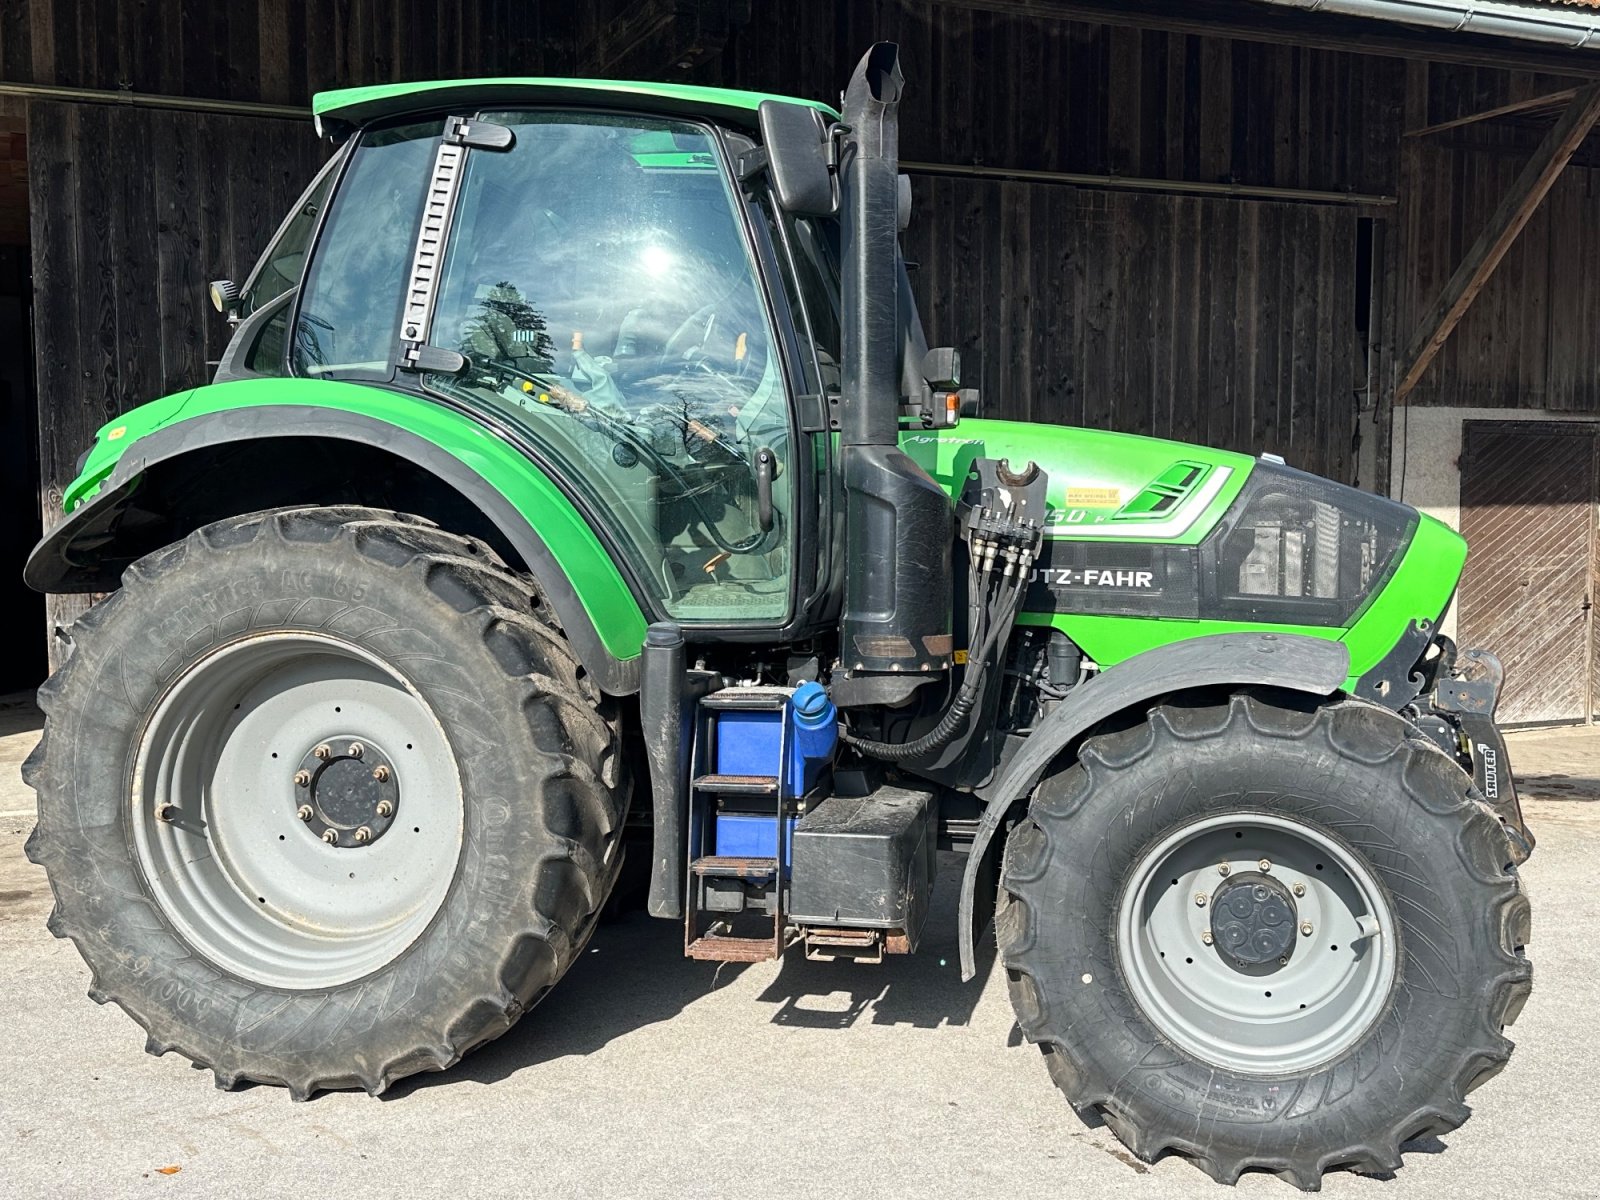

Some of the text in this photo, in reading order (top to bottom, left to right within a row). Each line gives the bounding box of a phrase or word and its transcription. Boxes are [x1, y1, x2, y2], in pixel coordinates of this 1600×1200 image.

[902, 435, 984, 445] Agrotron
[992, 568, 1153, 588] UTZ-FAHR
[1484, 750, 1498, 799] SAUTER
